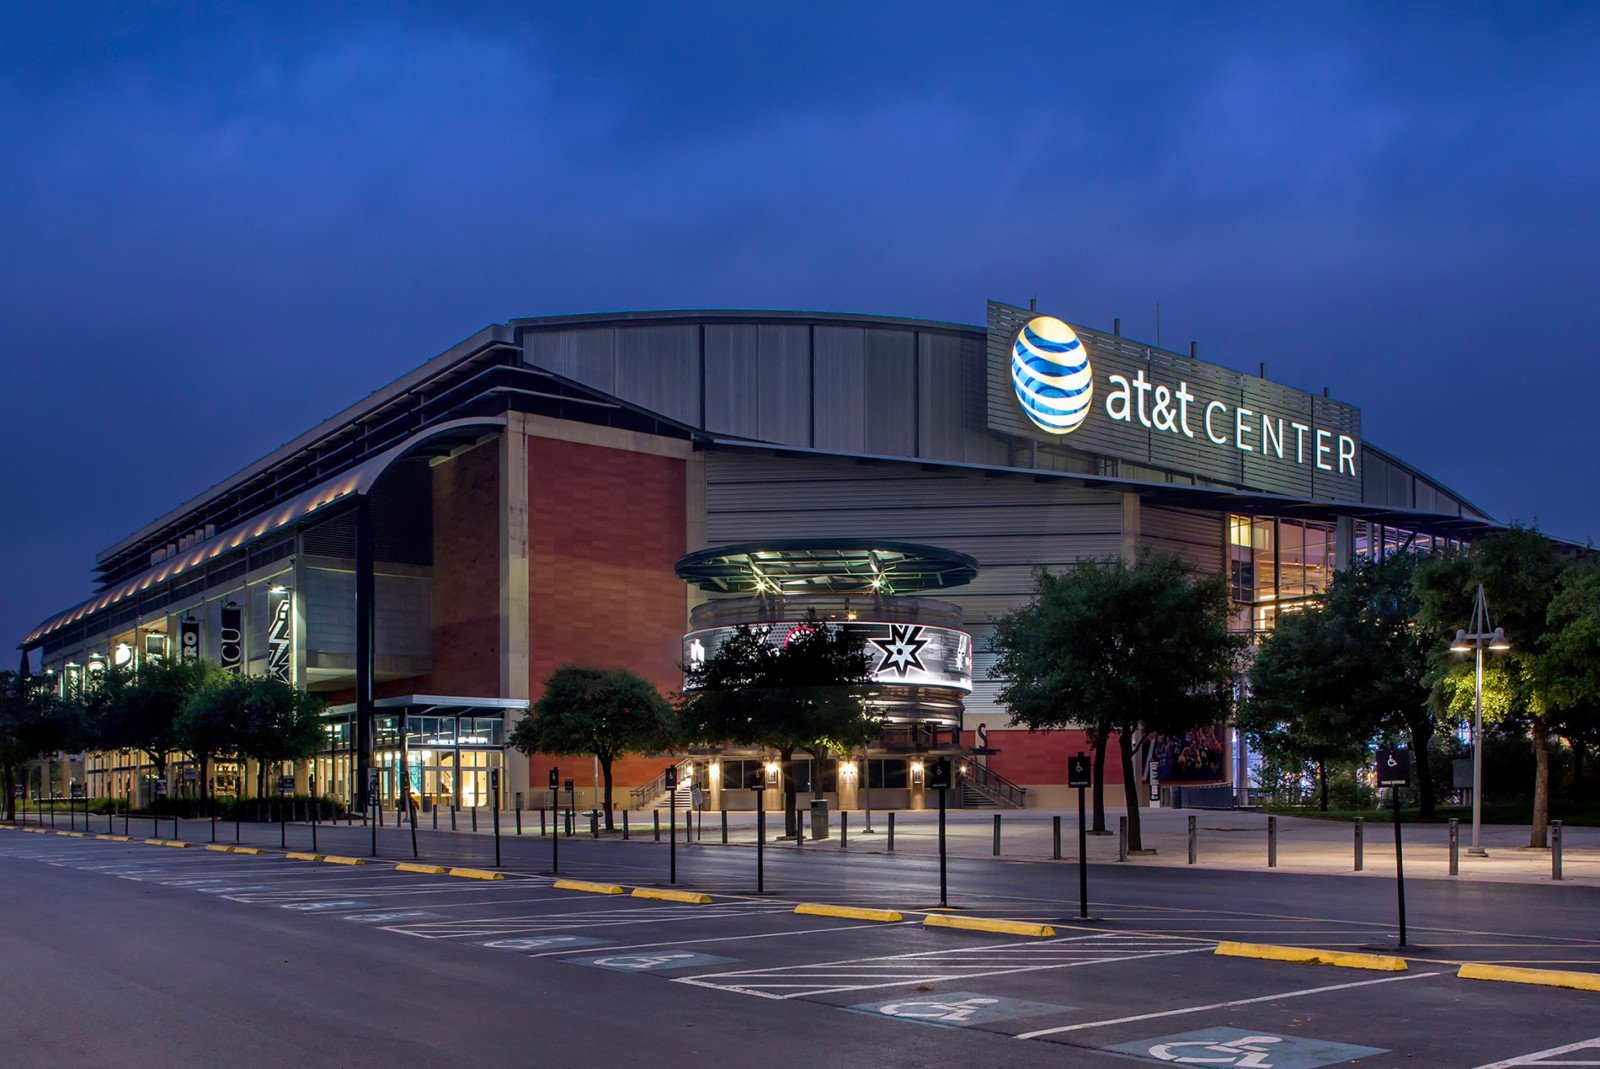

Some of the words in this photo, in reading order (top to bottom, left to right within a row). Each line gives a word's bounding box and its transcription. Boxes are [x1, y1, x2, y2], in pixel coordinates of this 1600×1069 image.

[1105, 370, 1194, 438] at&t
[1205, 401, 1356, 477] CENTER
[183, 631, 198, 662] RO
